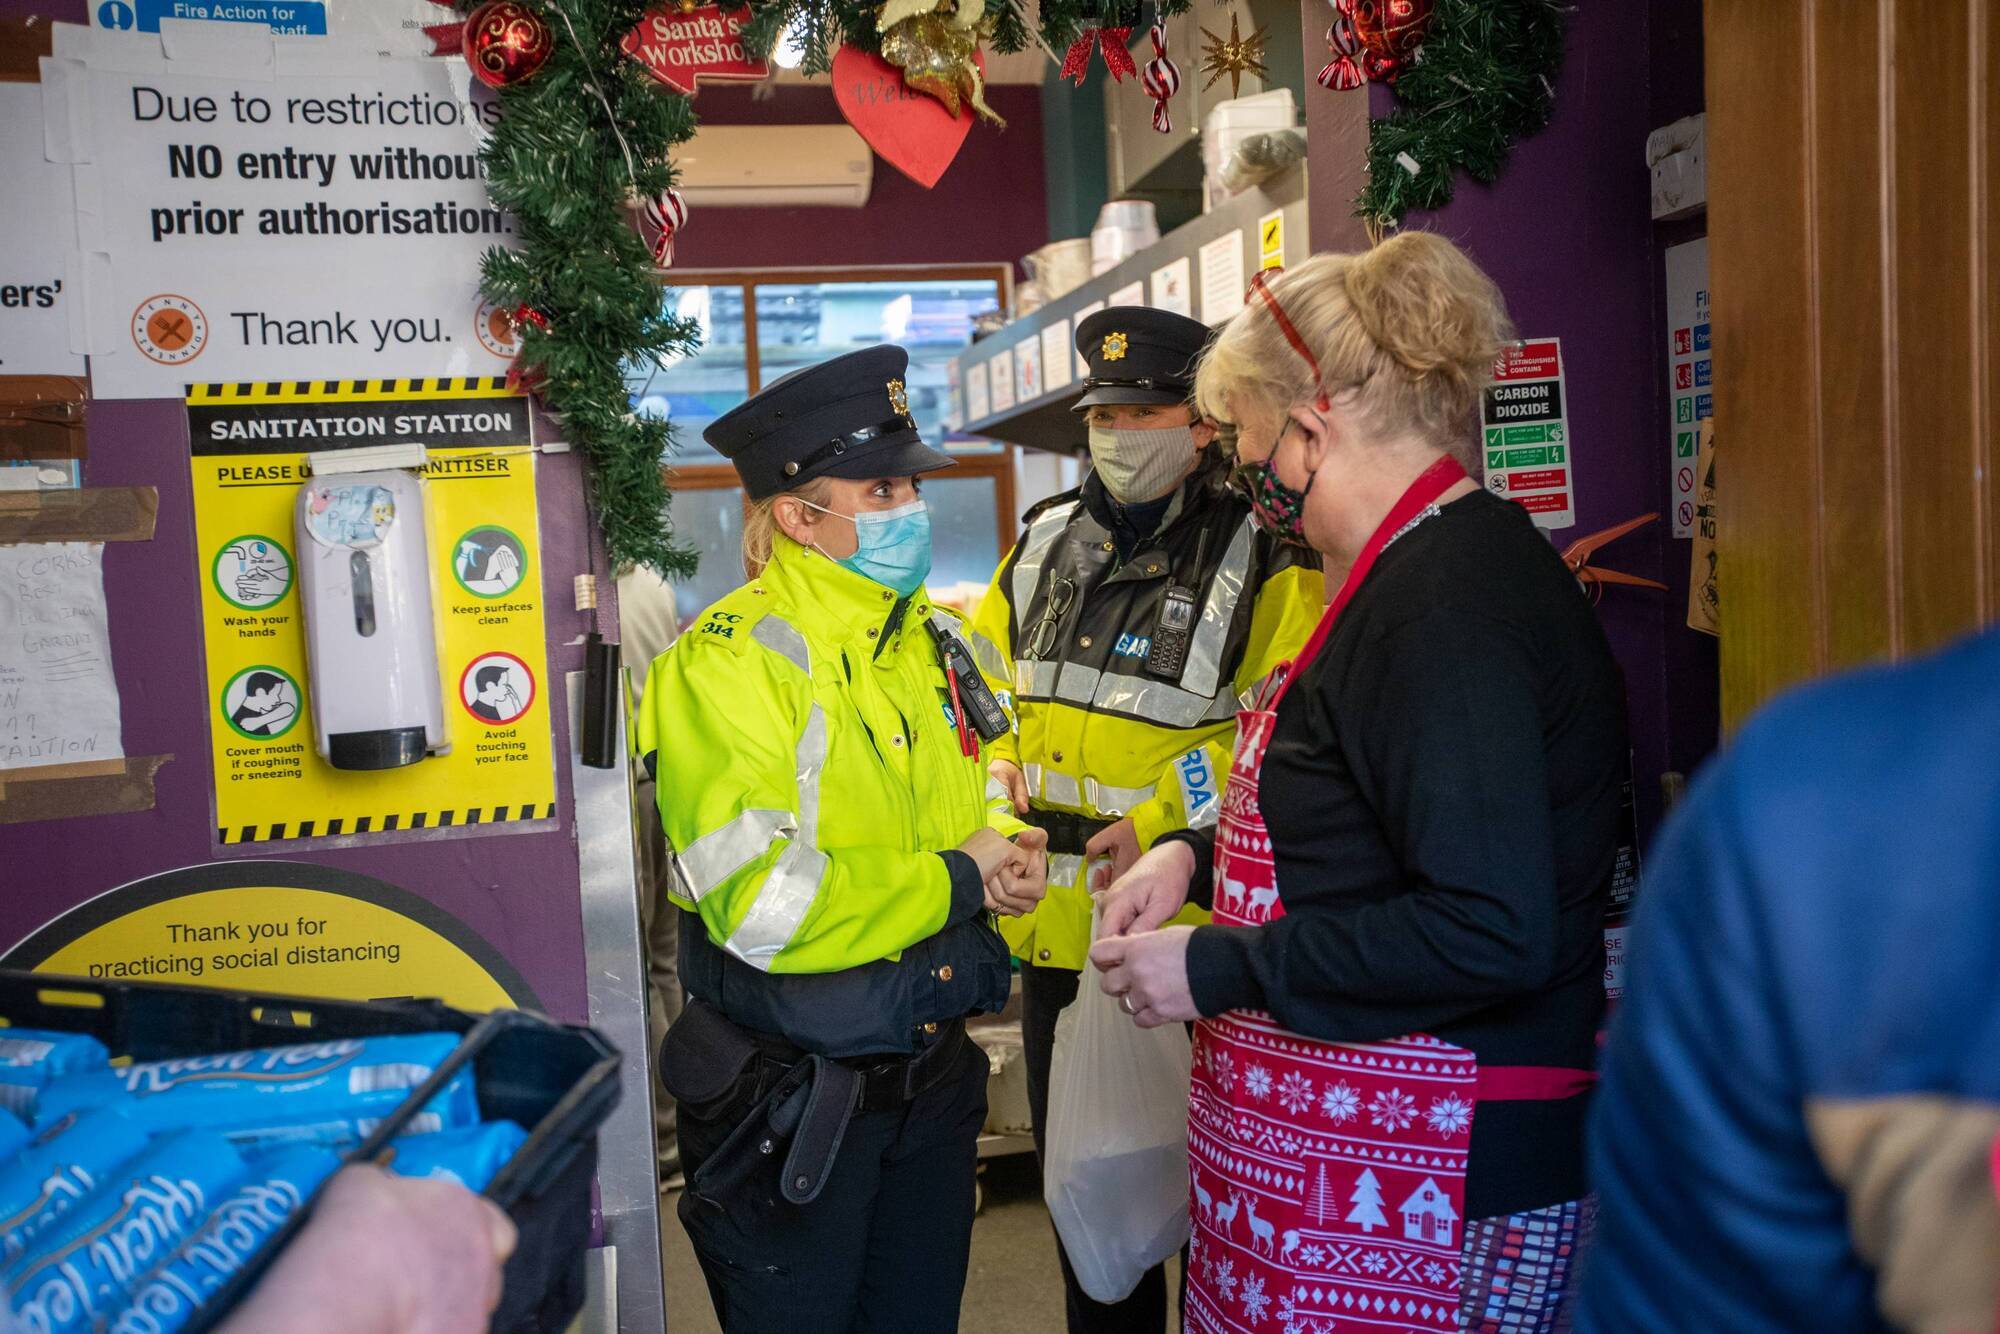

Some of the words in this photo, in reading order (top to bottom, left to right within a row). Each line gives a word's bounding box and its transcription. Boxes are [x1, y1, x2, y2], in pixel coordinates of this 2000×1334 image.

[174, 2, 208, 18] Fire
[212, 3, 266, 20] Action
[272, 6, 295, 20] for
[652, 15, 741, 42] Santa's
[132, 86, 218, 123] Due
[231, 90, 271, 124] to
[287, 92, 504, 128] restrictions
[168, 144, 223, 179] NO
[237, 147, 336, 187] entry
[151, 201, 244, 242] prior
[258, 201, 512, 236] authorisation.
[231, 311, 358, 347] Thank
[371, 316, 452, 353] you.
[1509, 366, 1542, 374] CONTAINS
[1494, 385, 1549, 401] CARBON
[1496, 402, 1550, 418] DIOXIDE
[210, 416, 386, 440] SANITATION
[394, 412, 513, 436] STATION
[218, 465, 291, 481] PLEASE
[416, 458, 510, 475] ANITISER
[452, 604, 481, 616] Keep
[484, 602, 533, 614] surfaces
[224, 616, 258, 627] Wash
[260, 615, 290, 628] your
[478, 614, 509, 625] clean
[712, 611, 744, 624] CC
[239, 627, 276, 638] hands
[701, 622, 735, 640] 314
[1115, 632, 1152, 658] GAR
[484, 729, 517, 739] Avoid
[226, 747, 261, 758] Cover
[265, 743, 304, 755] mouth
[476, 740, 527, 753] touching
[231, 759, 242, 769] if
[243, 755, 301, 770] coughing
[475, 755, 502, 766] your
[505, 751, 529, 762] face
[231, 772, 245, 782] or
[248, 768, 303, 782] sneezing
[166, 921, 240, 944] Thank
[248, 923, 289, 943] you
[297, 917, 327, 936] for
[89, 955, 204, 978] practicing
[212, 947, 278, 970] social
[286, 941, 400, 965] distancing
